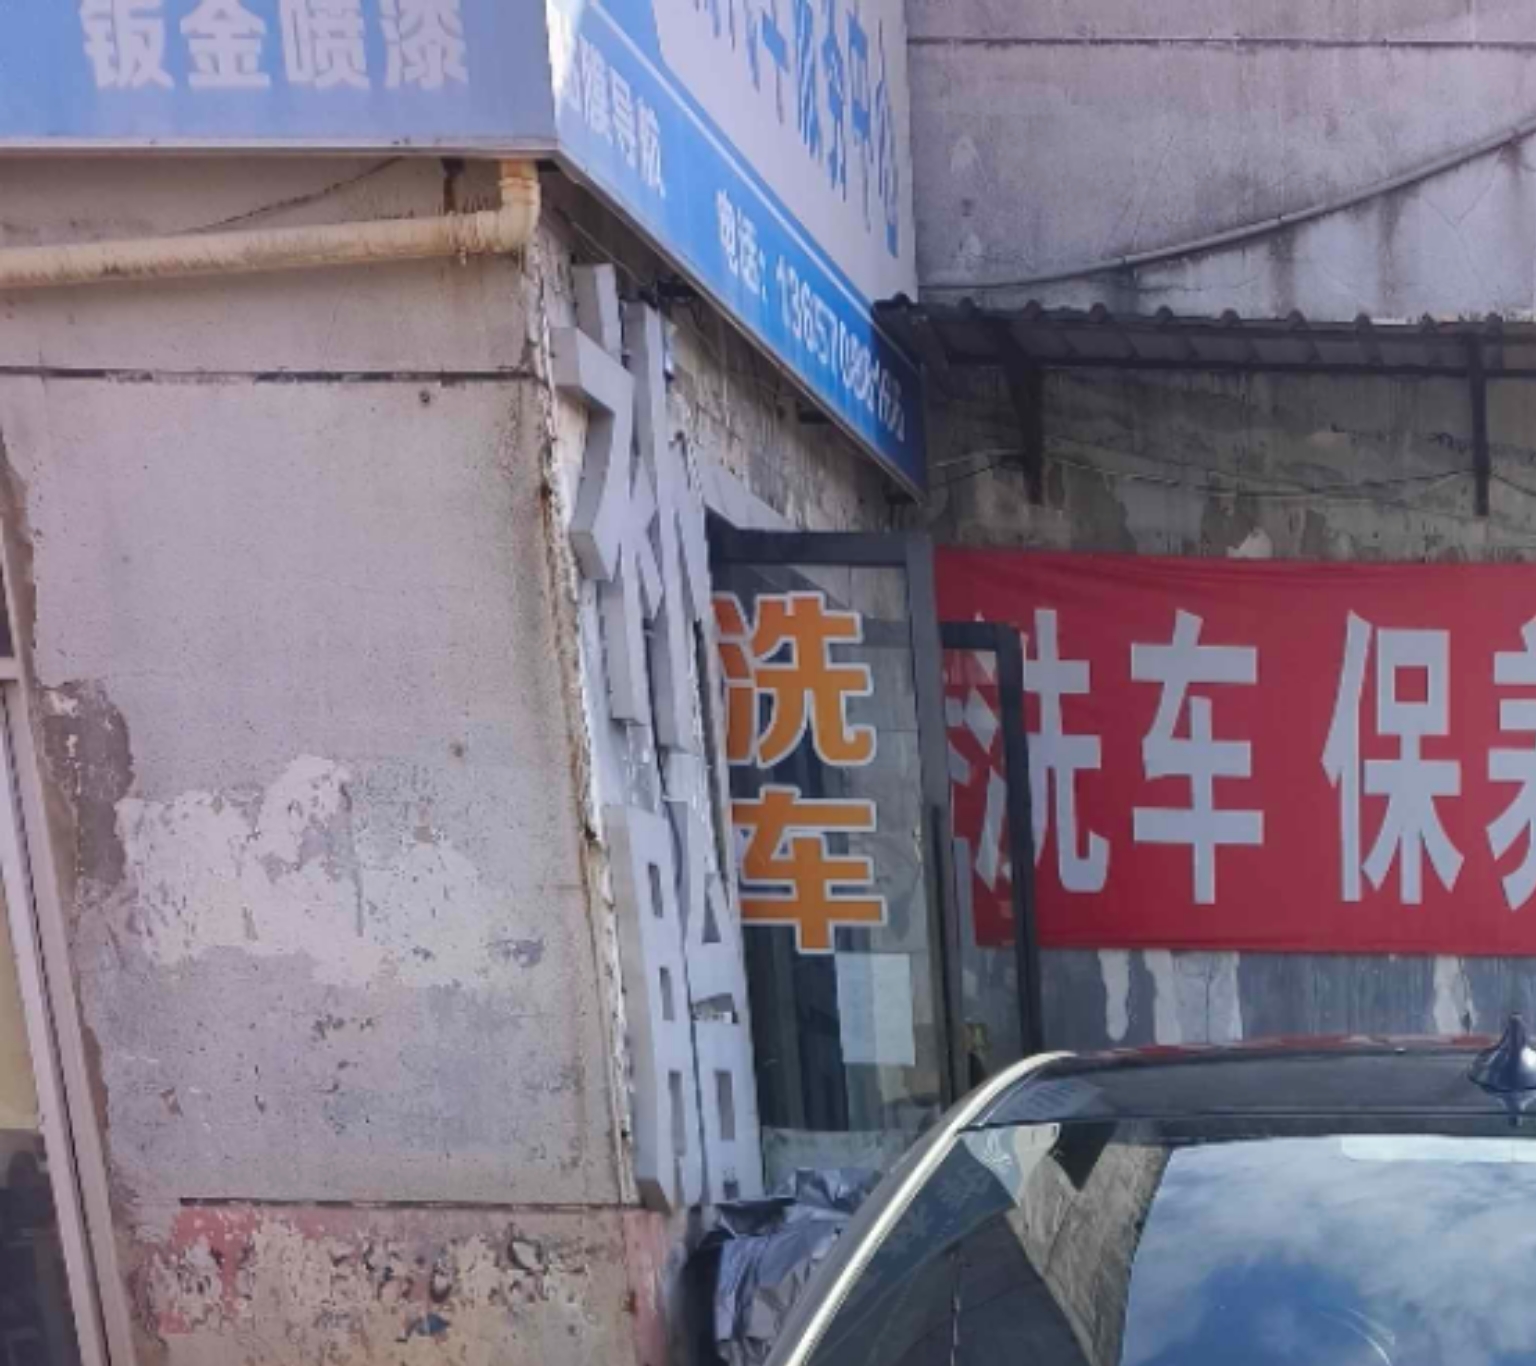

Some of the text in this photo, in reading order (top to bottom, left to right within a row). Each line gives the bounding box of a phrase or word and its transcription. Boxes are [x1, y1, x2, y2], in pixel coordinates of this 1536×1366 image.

[79, 0, 469, 90] 钣金喷漆
[709, 590, 887, 956] 洗车
